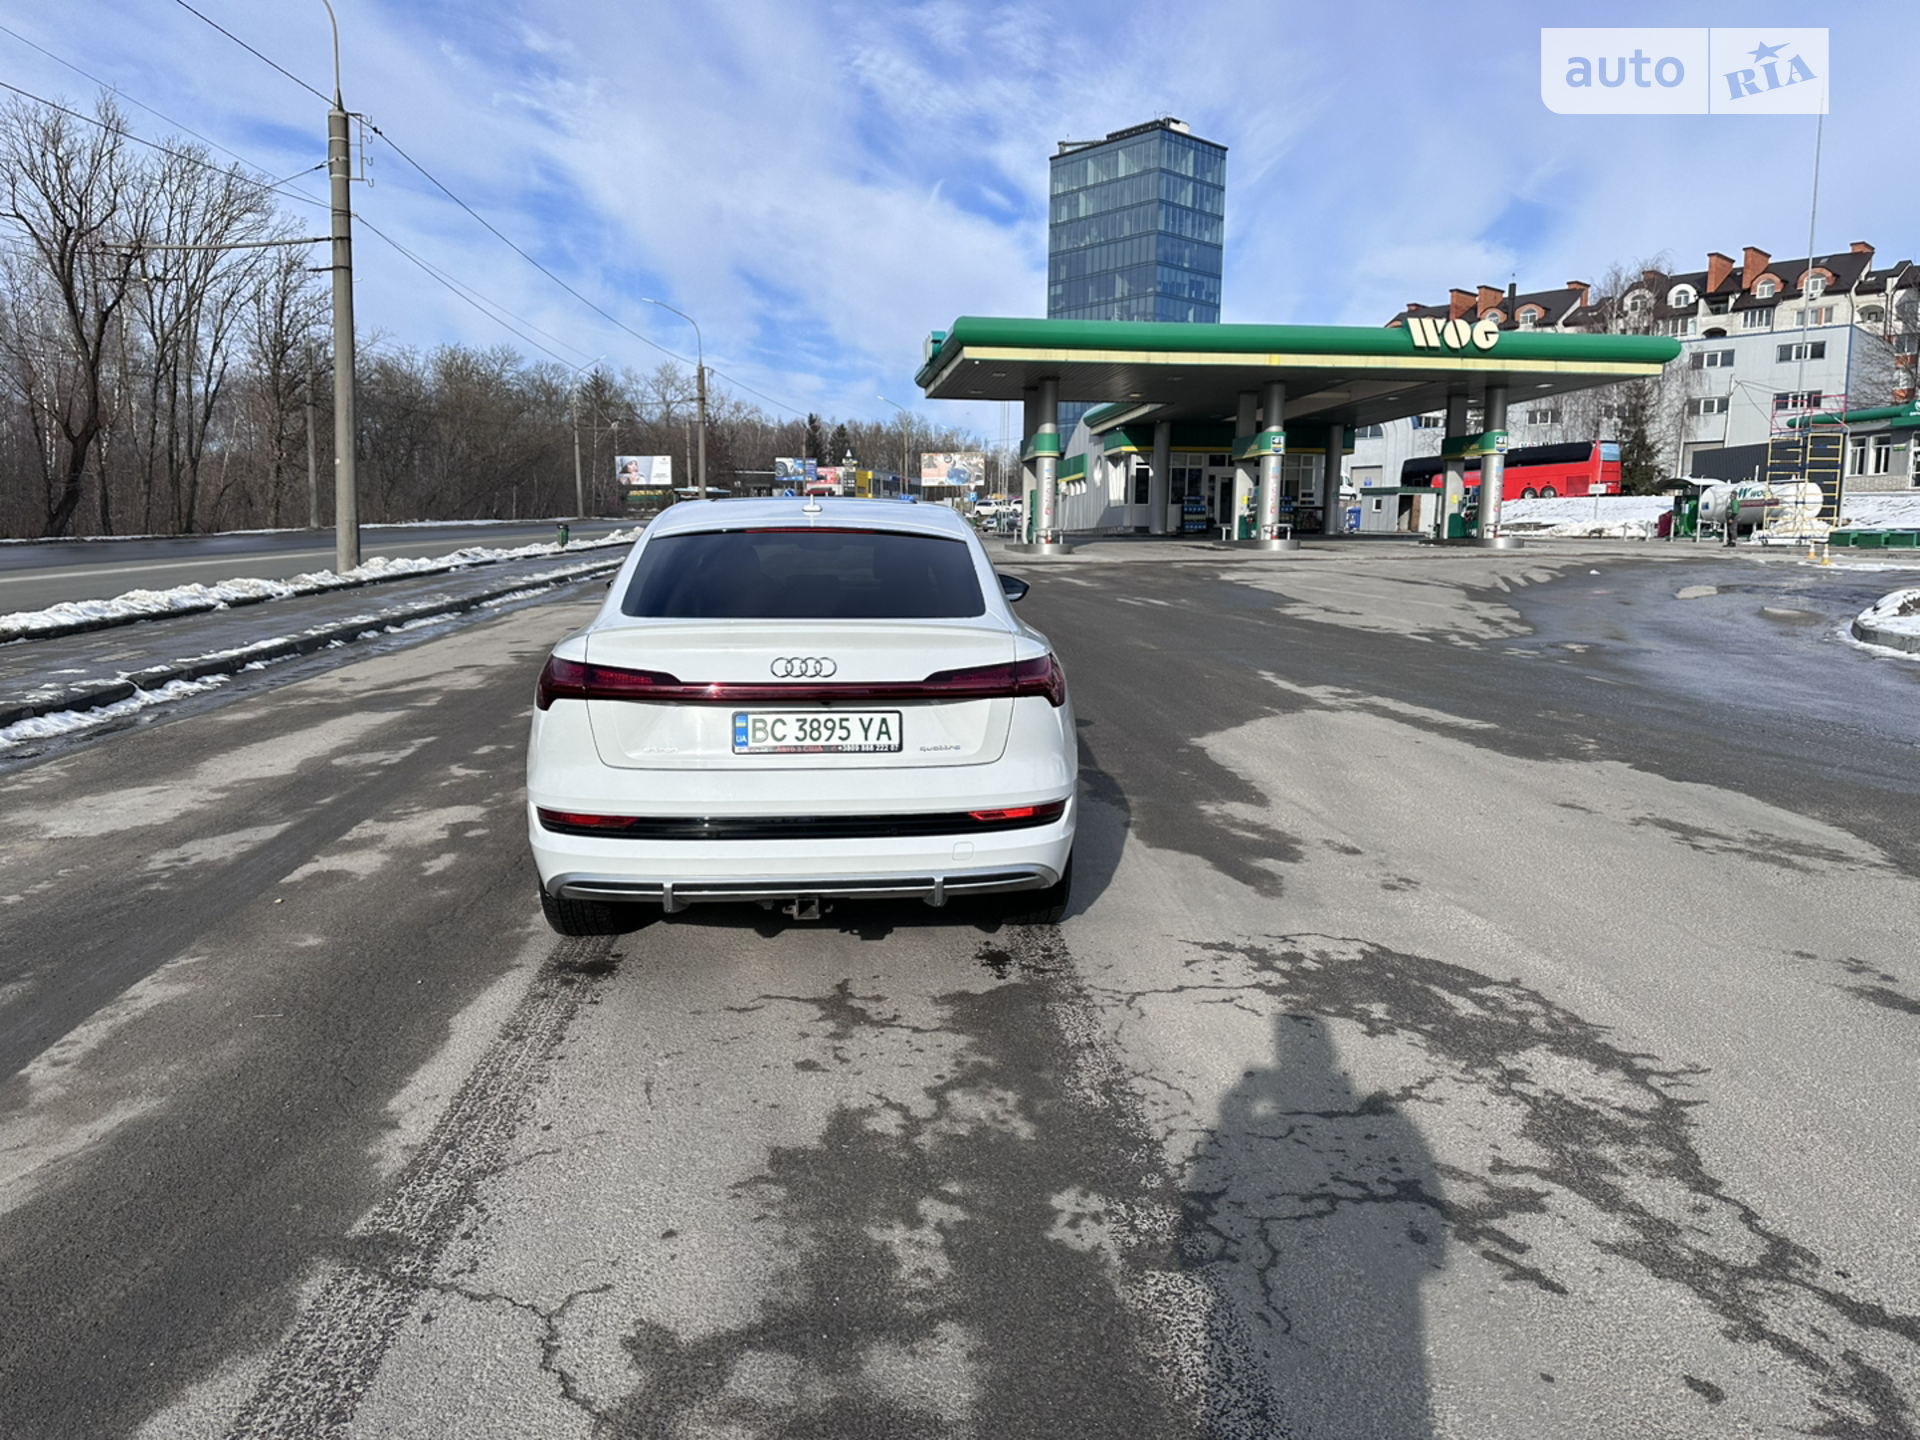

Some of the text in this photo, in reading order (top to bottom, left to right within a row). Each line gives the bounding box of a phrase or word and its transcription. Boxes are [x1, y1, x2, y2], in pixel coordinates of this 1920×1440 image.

[1406, 317, 1500, 350] WOG
[751, 717, 892, 743] BC 3895 YA
[919, 744, 961, 752] quattro
